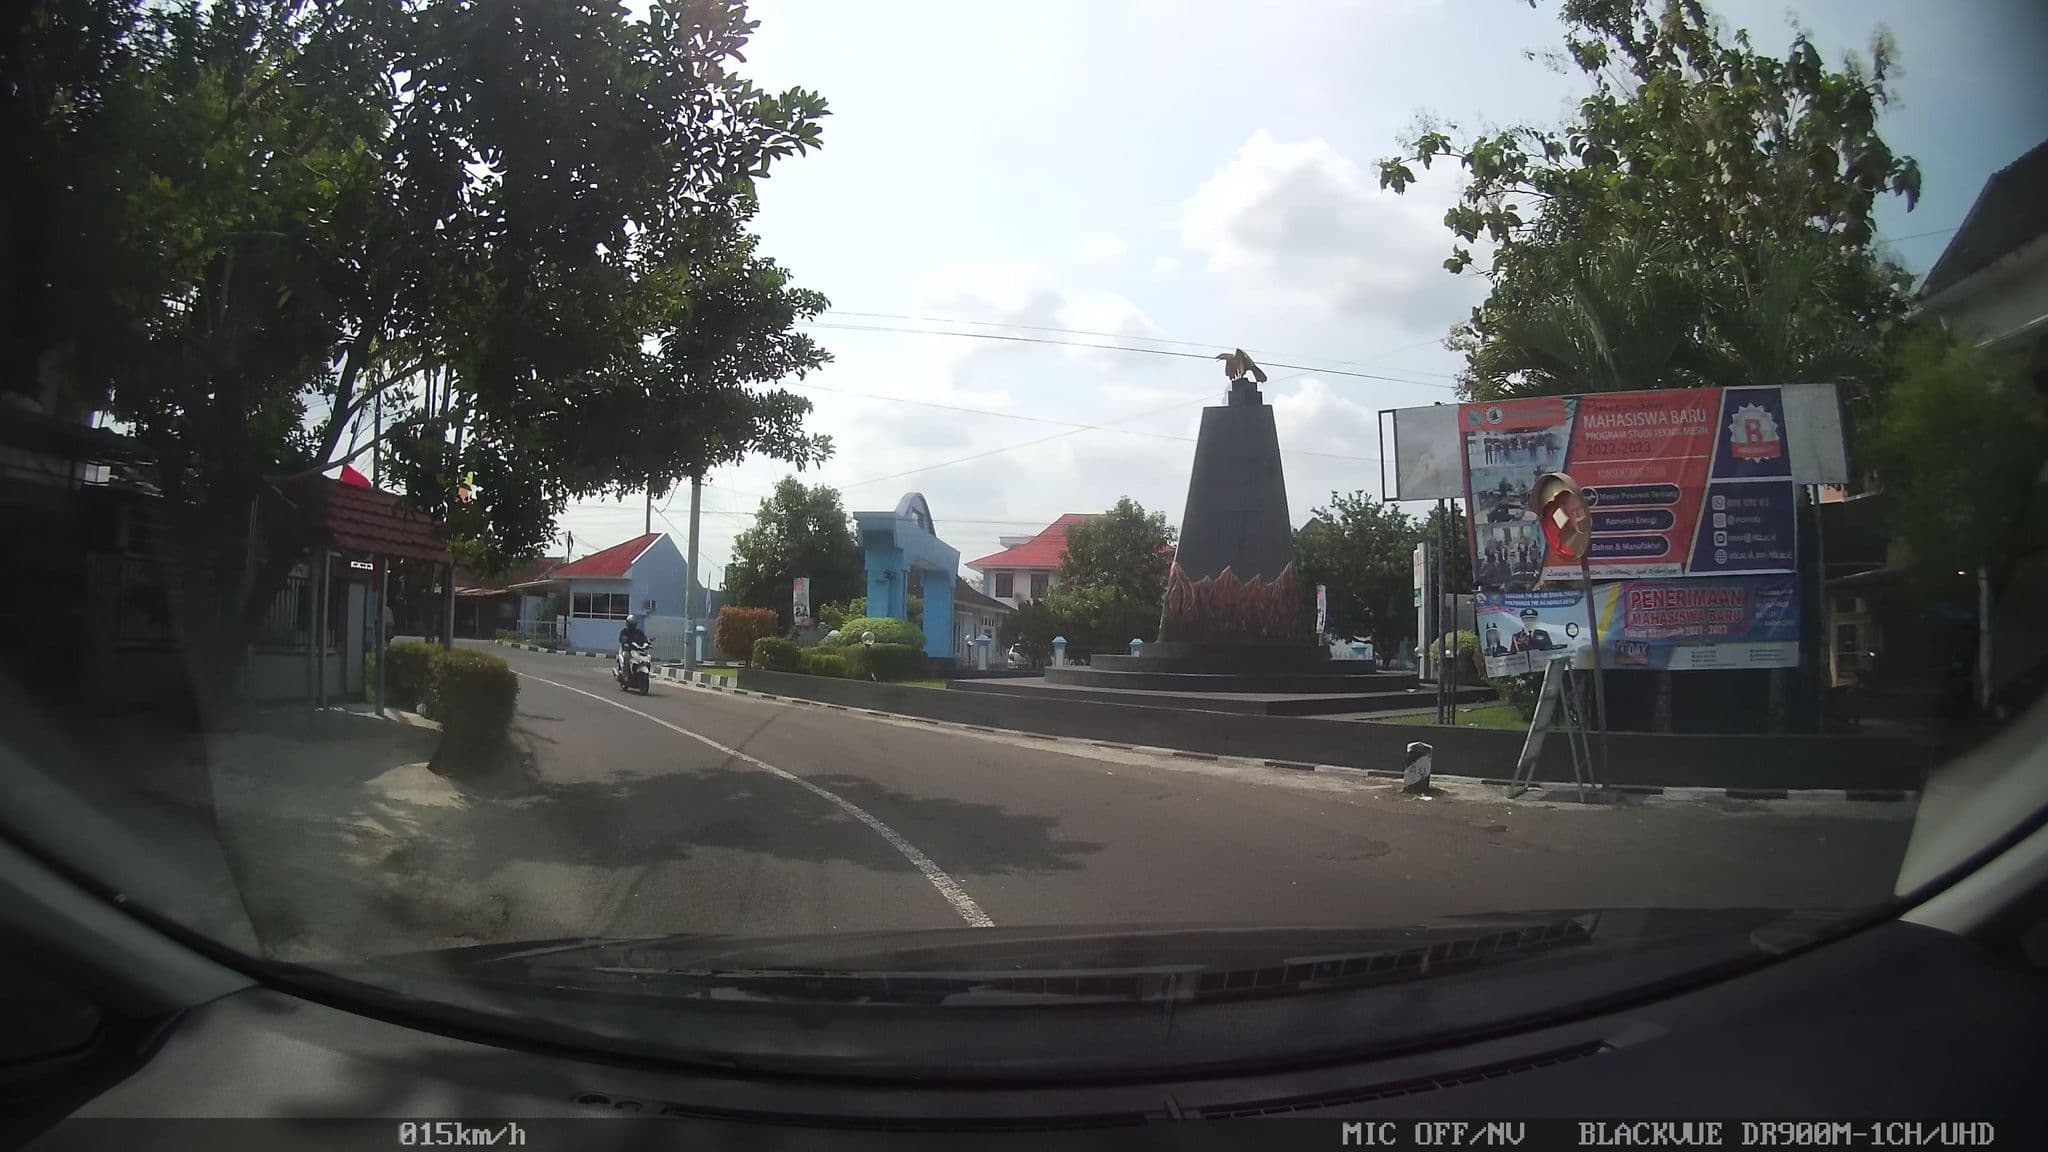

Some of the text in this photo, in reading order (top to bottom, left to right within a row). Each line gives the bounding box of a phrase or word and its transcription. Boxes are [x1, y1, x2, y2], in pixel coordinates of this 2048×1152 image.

[1584, 409, 1706, 430] MAHASISWA BARU
[1585, 430, 1626, 441] PROGRAM
[1630, 587, 1744, 610] PENERIMAAN
[1631, 610, 1704, 626] MAHASISWA
[1708, 608, 1743, 624] BARU
